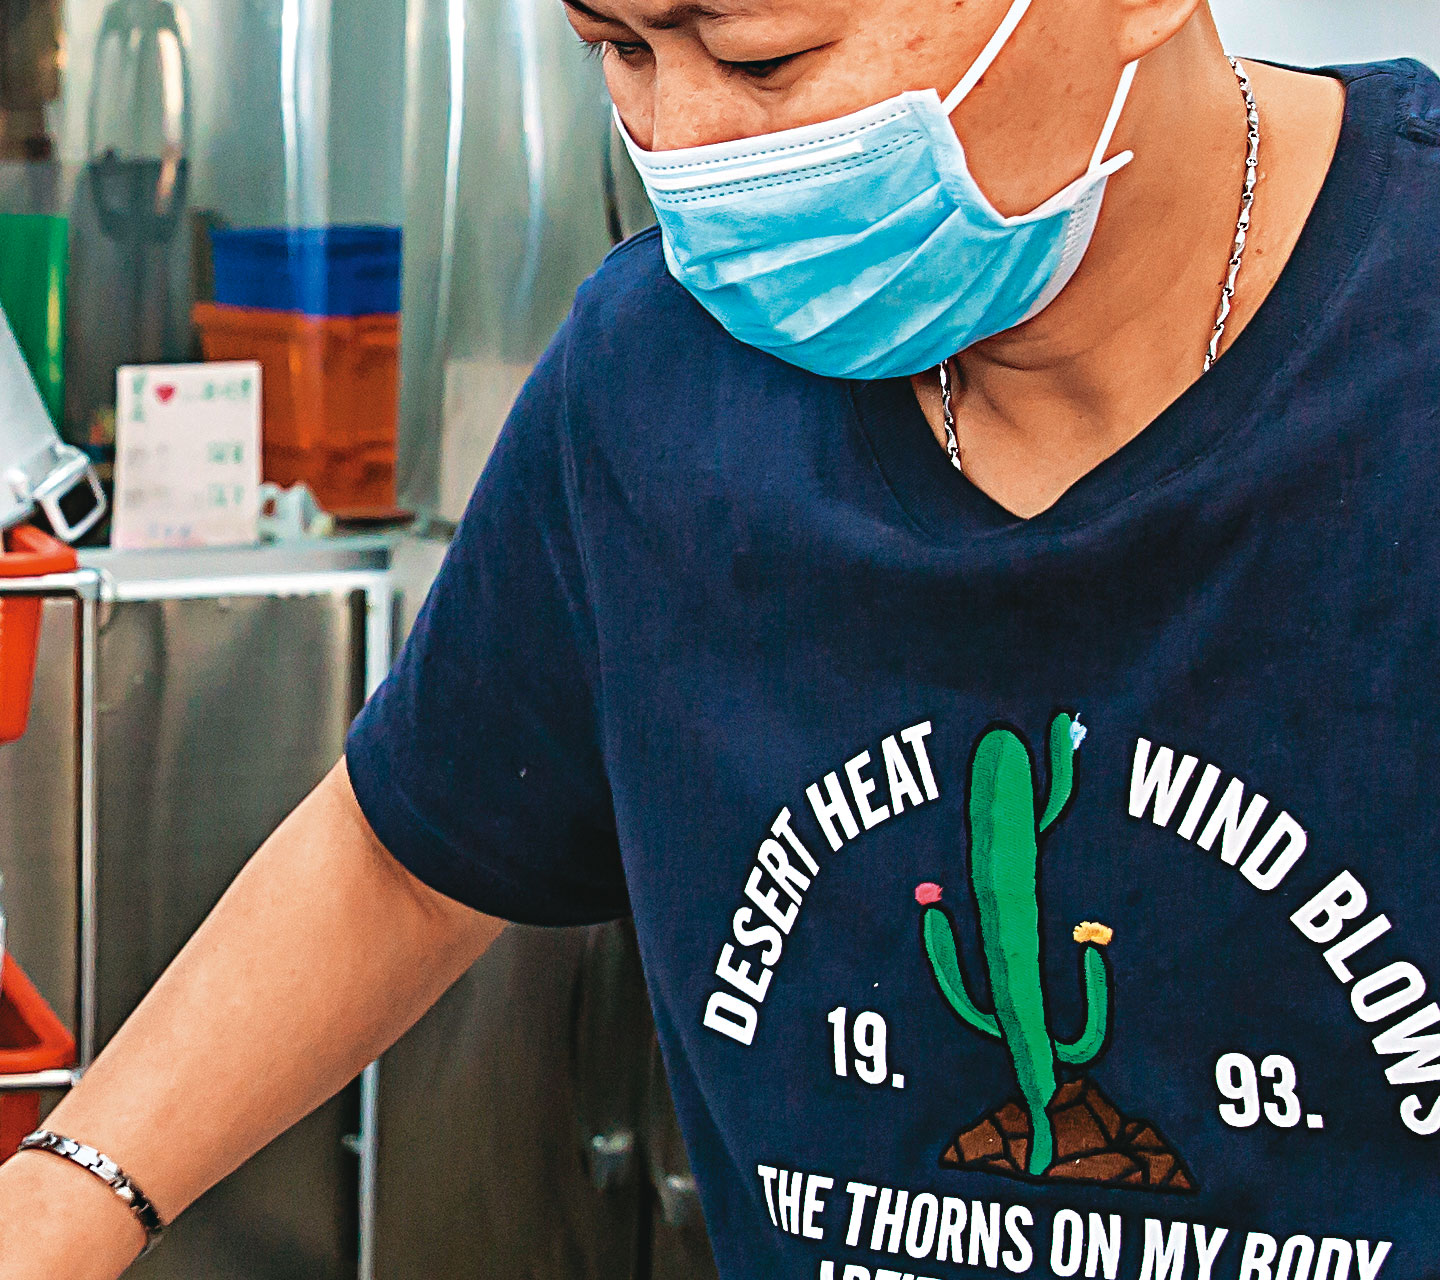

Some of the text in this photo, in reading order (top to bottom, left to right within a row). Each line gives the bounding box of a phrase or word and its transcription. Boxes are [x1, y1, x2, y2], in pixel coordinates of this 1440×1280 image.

[1128, 737, 1307, 891] WIND
[703, 720, 939, 1046] DESERT HEAT
[827, 1006, 905, 1089] 19.
[1215, 1052, 1324, 1129] 93.
[757, 1164, 834, 1240] THE
[845, 1181, 1034, 1273] THORNS
[1050, 1208, 1122, 1280] ON
